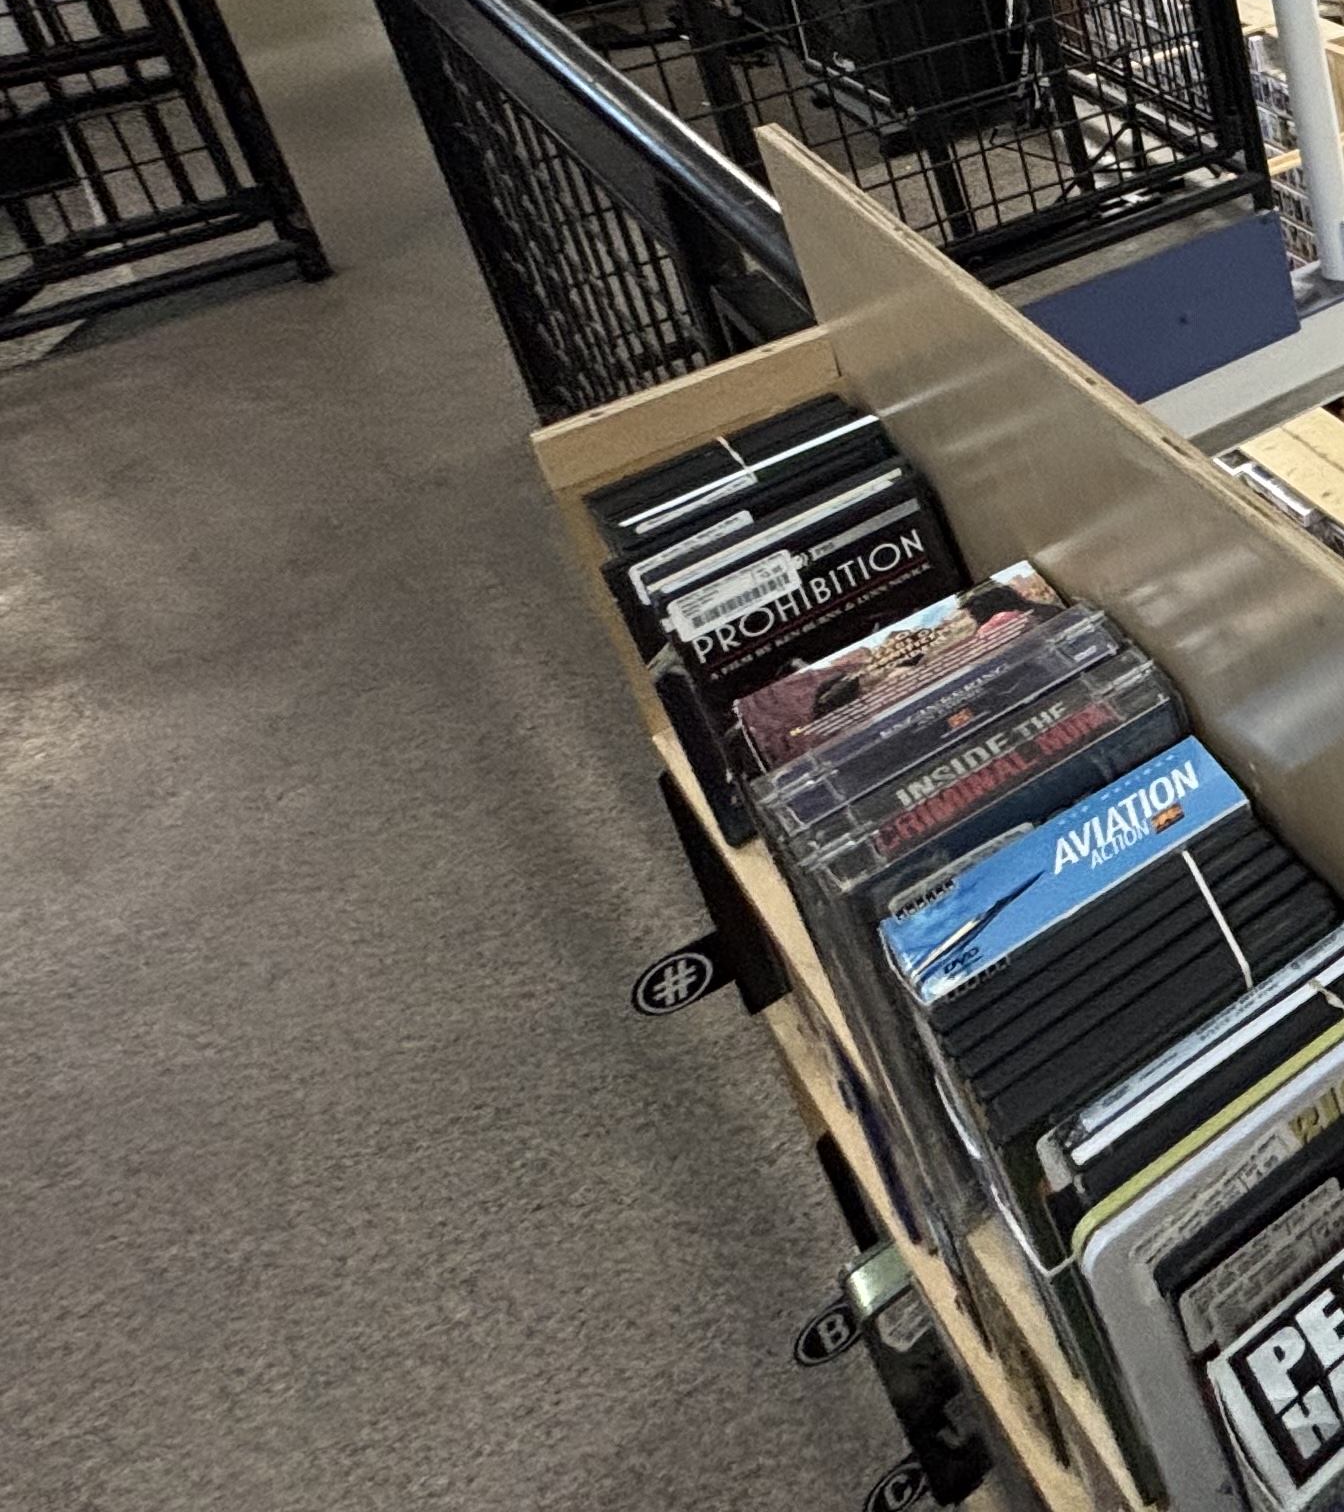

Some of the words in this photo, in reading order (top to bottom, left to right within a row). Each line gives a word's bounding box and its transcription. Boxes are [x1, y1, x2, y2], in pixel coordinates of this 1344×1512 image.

[697, 529, 924, 664] PROHIBITION
[896, 735, 1009, 807] INSIDE
[1010, 700, 1068, 746] THE
[1054, 760, 1199, 875] AVIATION
[1090, 819, 1152, 870] ACTION
[817, 1311, 847, 1353] B
